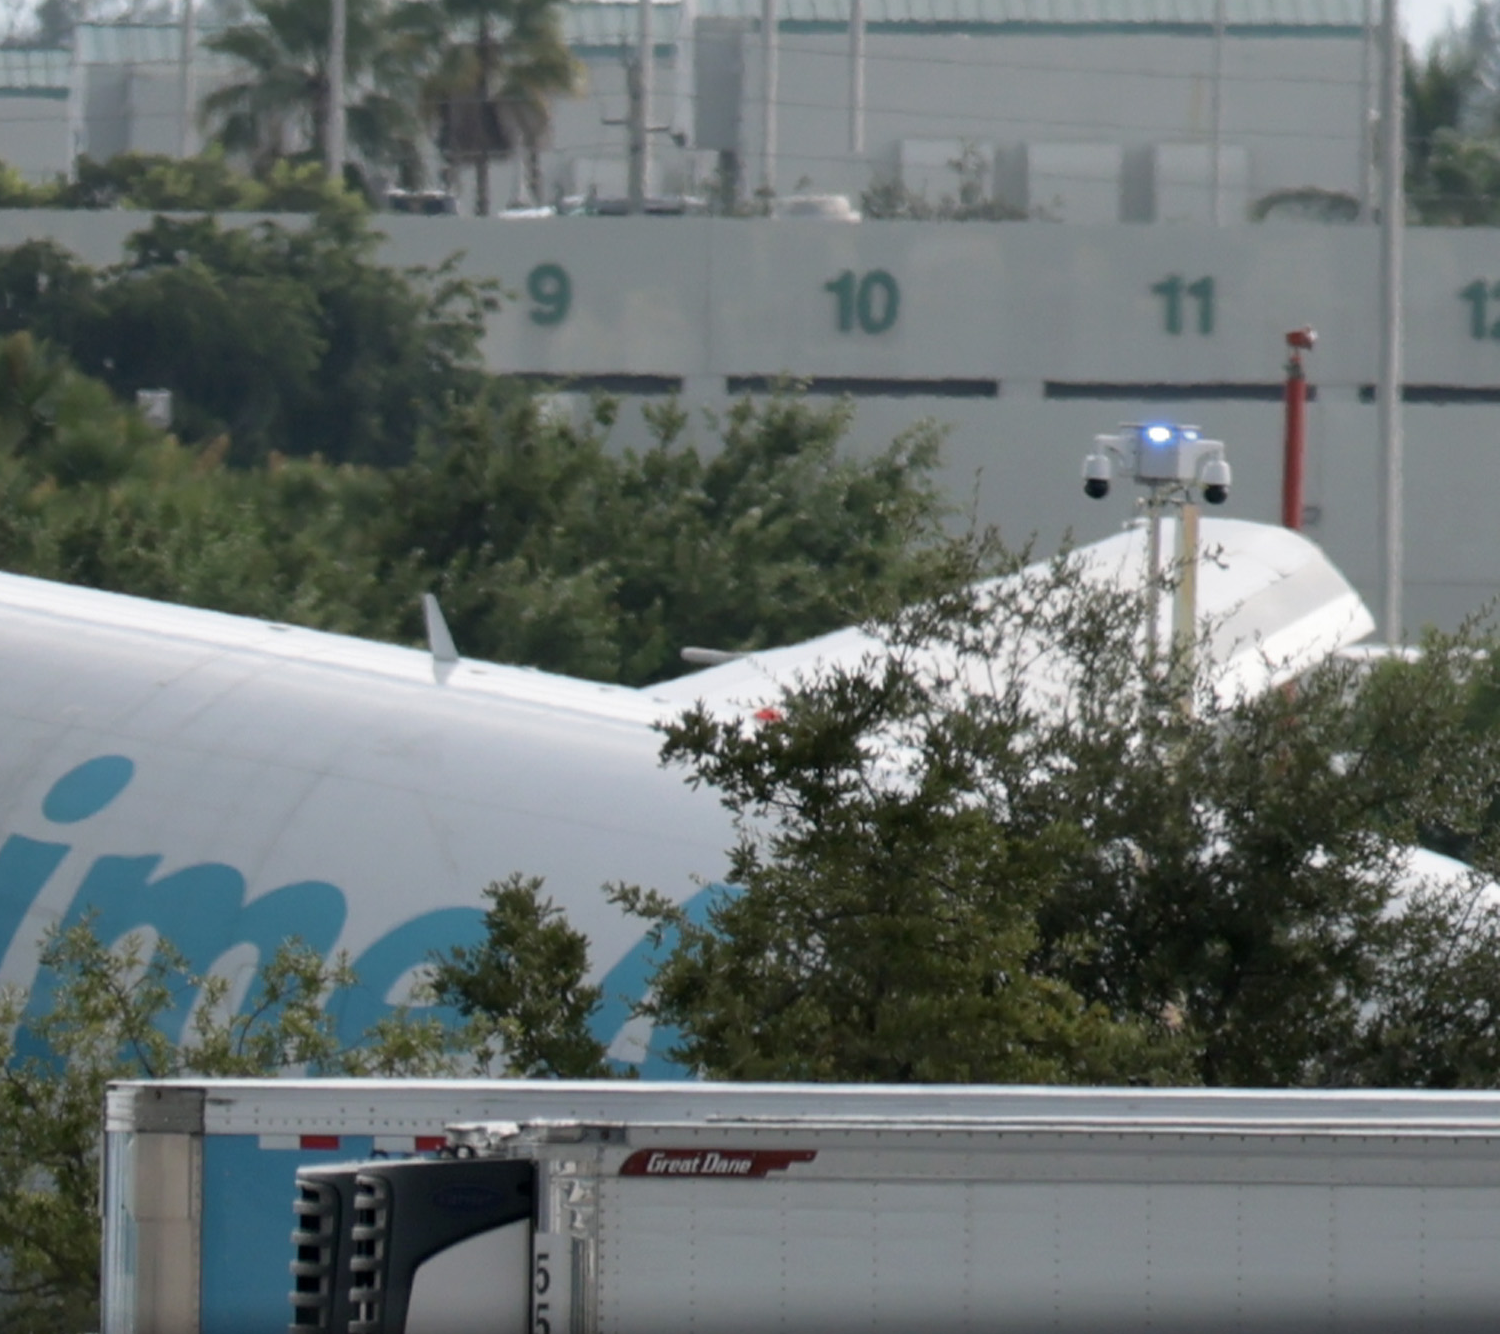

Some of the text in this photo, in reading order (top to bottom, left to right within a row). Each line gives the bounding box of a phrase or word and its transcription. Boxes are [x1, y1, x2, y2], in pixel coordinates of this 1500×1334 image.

[528, 264, 572, 327] 9
[825, 269, 898, 335] 10
[1152, 274, 1216, 337] 11
[646, 1152, 752, 1174] Great Dane
